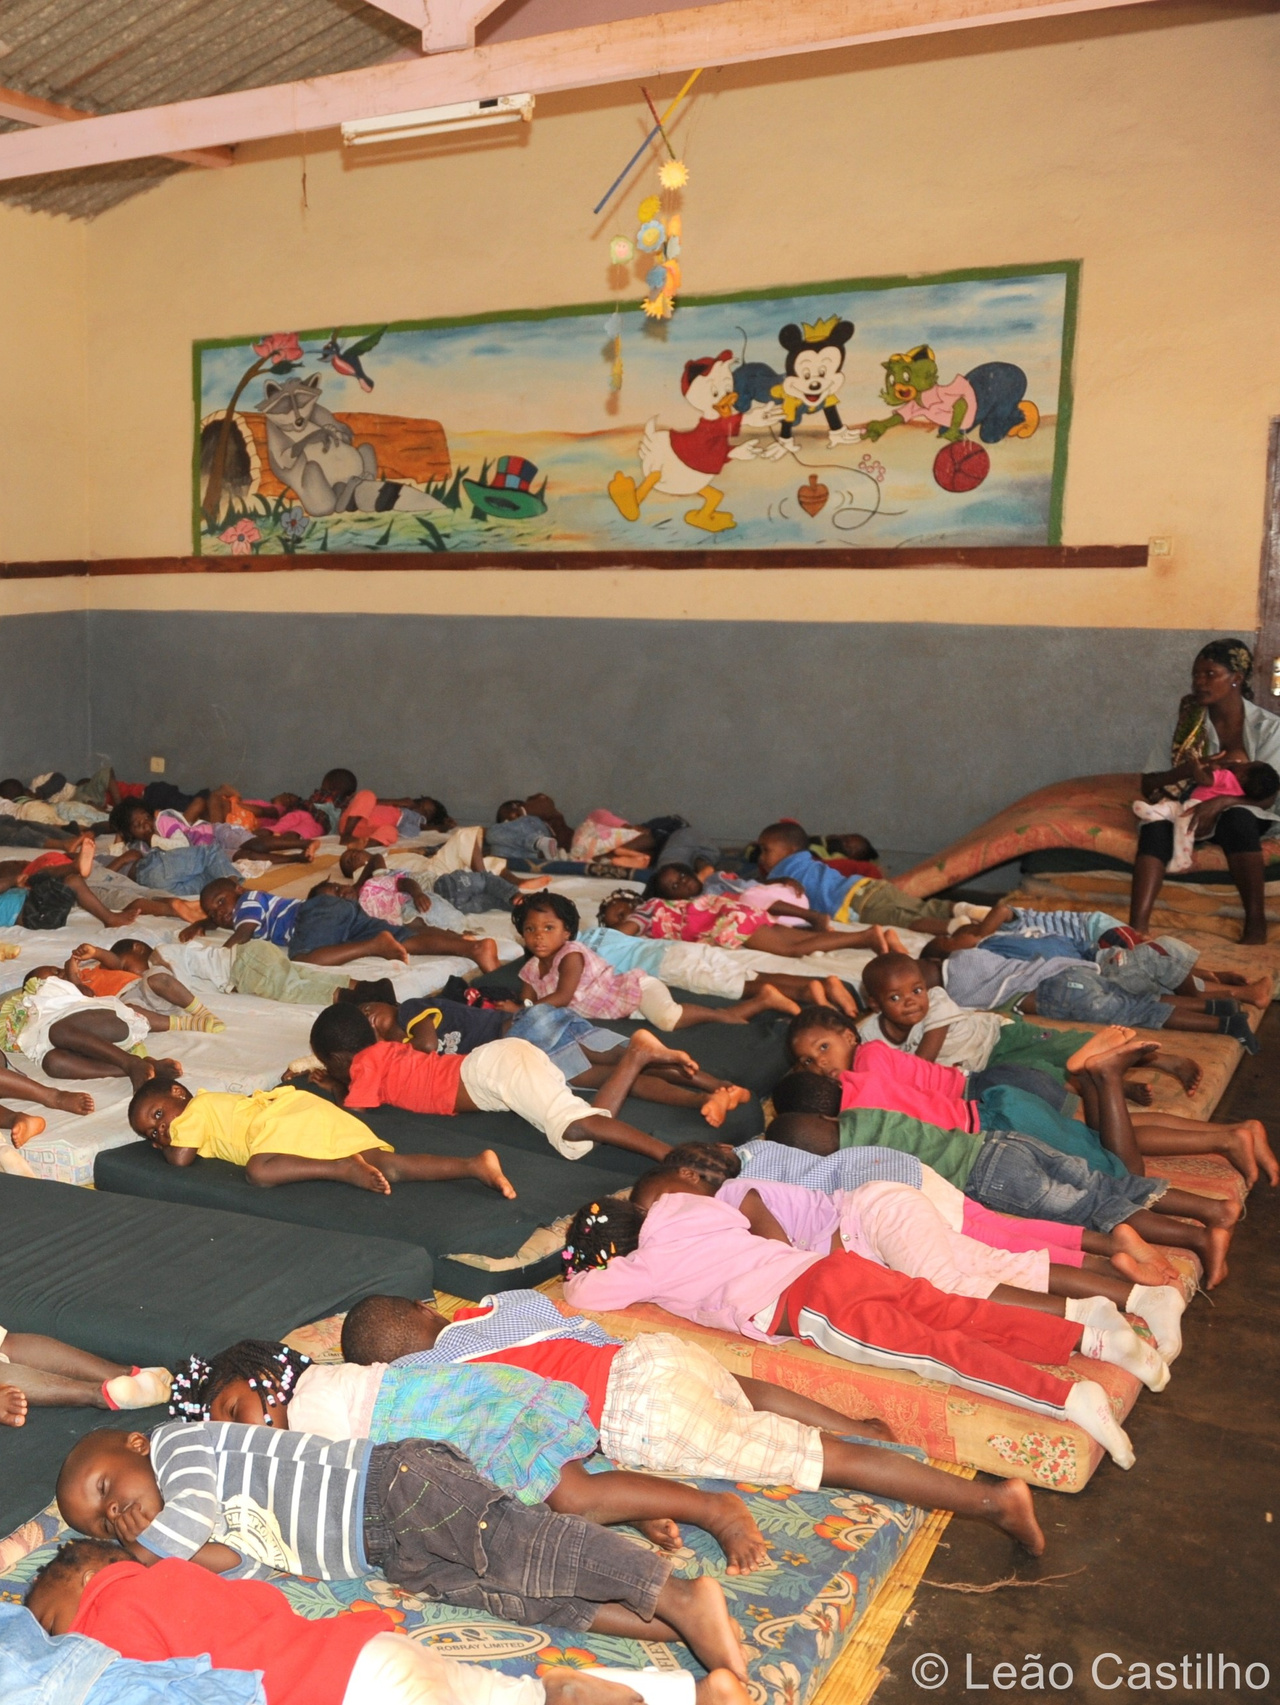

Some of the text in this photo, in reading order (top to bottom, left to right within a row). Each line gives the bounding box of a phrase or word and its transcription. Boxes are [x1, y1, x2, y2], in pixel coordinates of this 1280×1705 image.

[225, 1511, 286, 1570] CHPIONHIP
[436, 1642, 525, 1652] ROBRAY LIMITED
